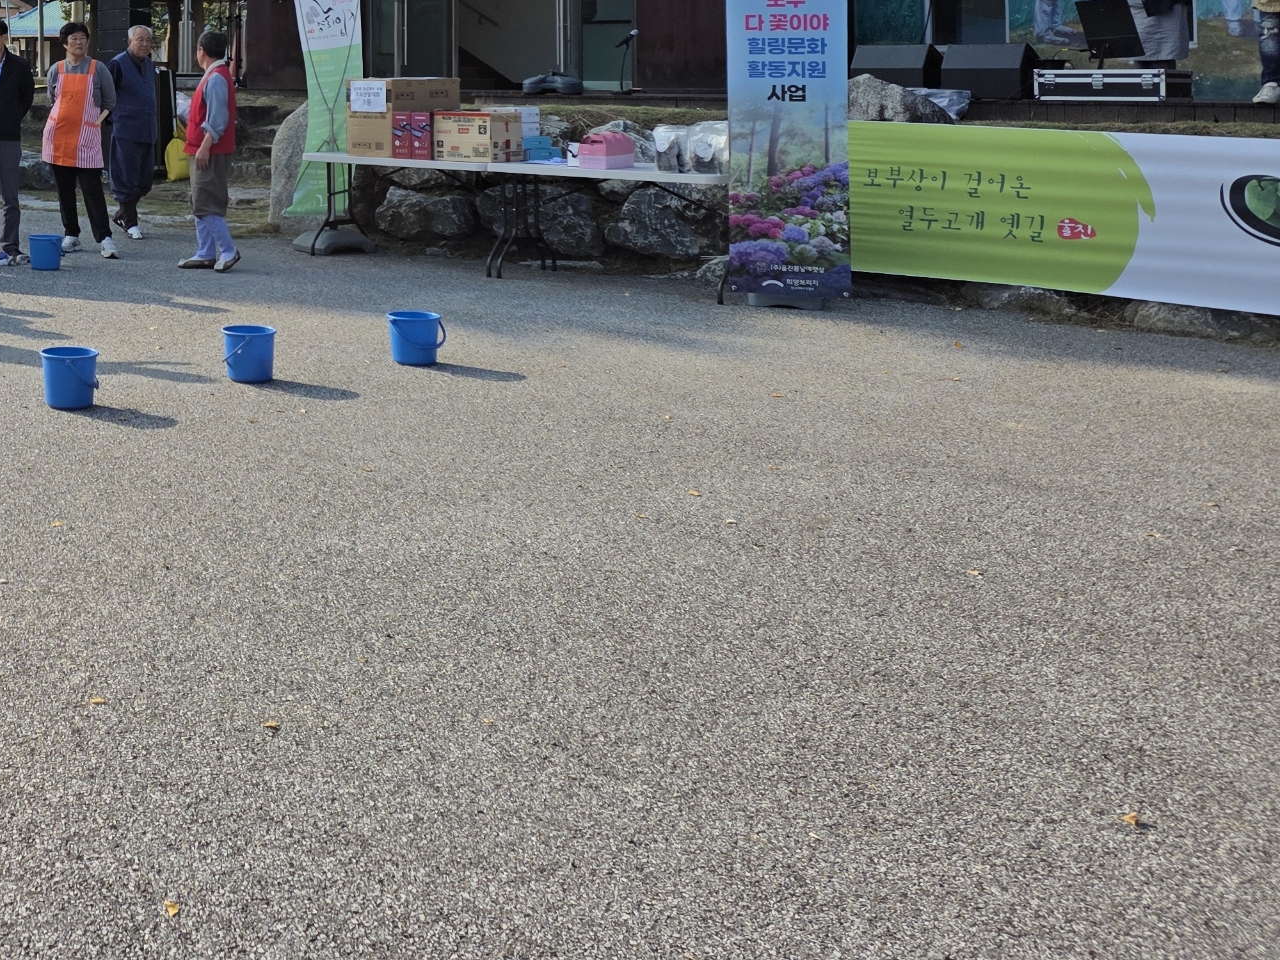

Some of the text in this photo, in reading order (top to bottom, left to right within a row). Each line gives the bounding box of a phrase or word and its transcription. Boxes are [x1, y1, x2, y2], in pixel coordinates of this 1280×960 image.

[744, 13, 830, 32] 다 꽃이야
[747, 37, 828, 55] 힐링문화
[747, 60, 827, 78] 활동지원
[767, 84, 806, 102] 사업
[863, 166, 1031, 199] 보부상이 걸어온
[898, 205, 1092, 243] 열두고개 옛길 울진
